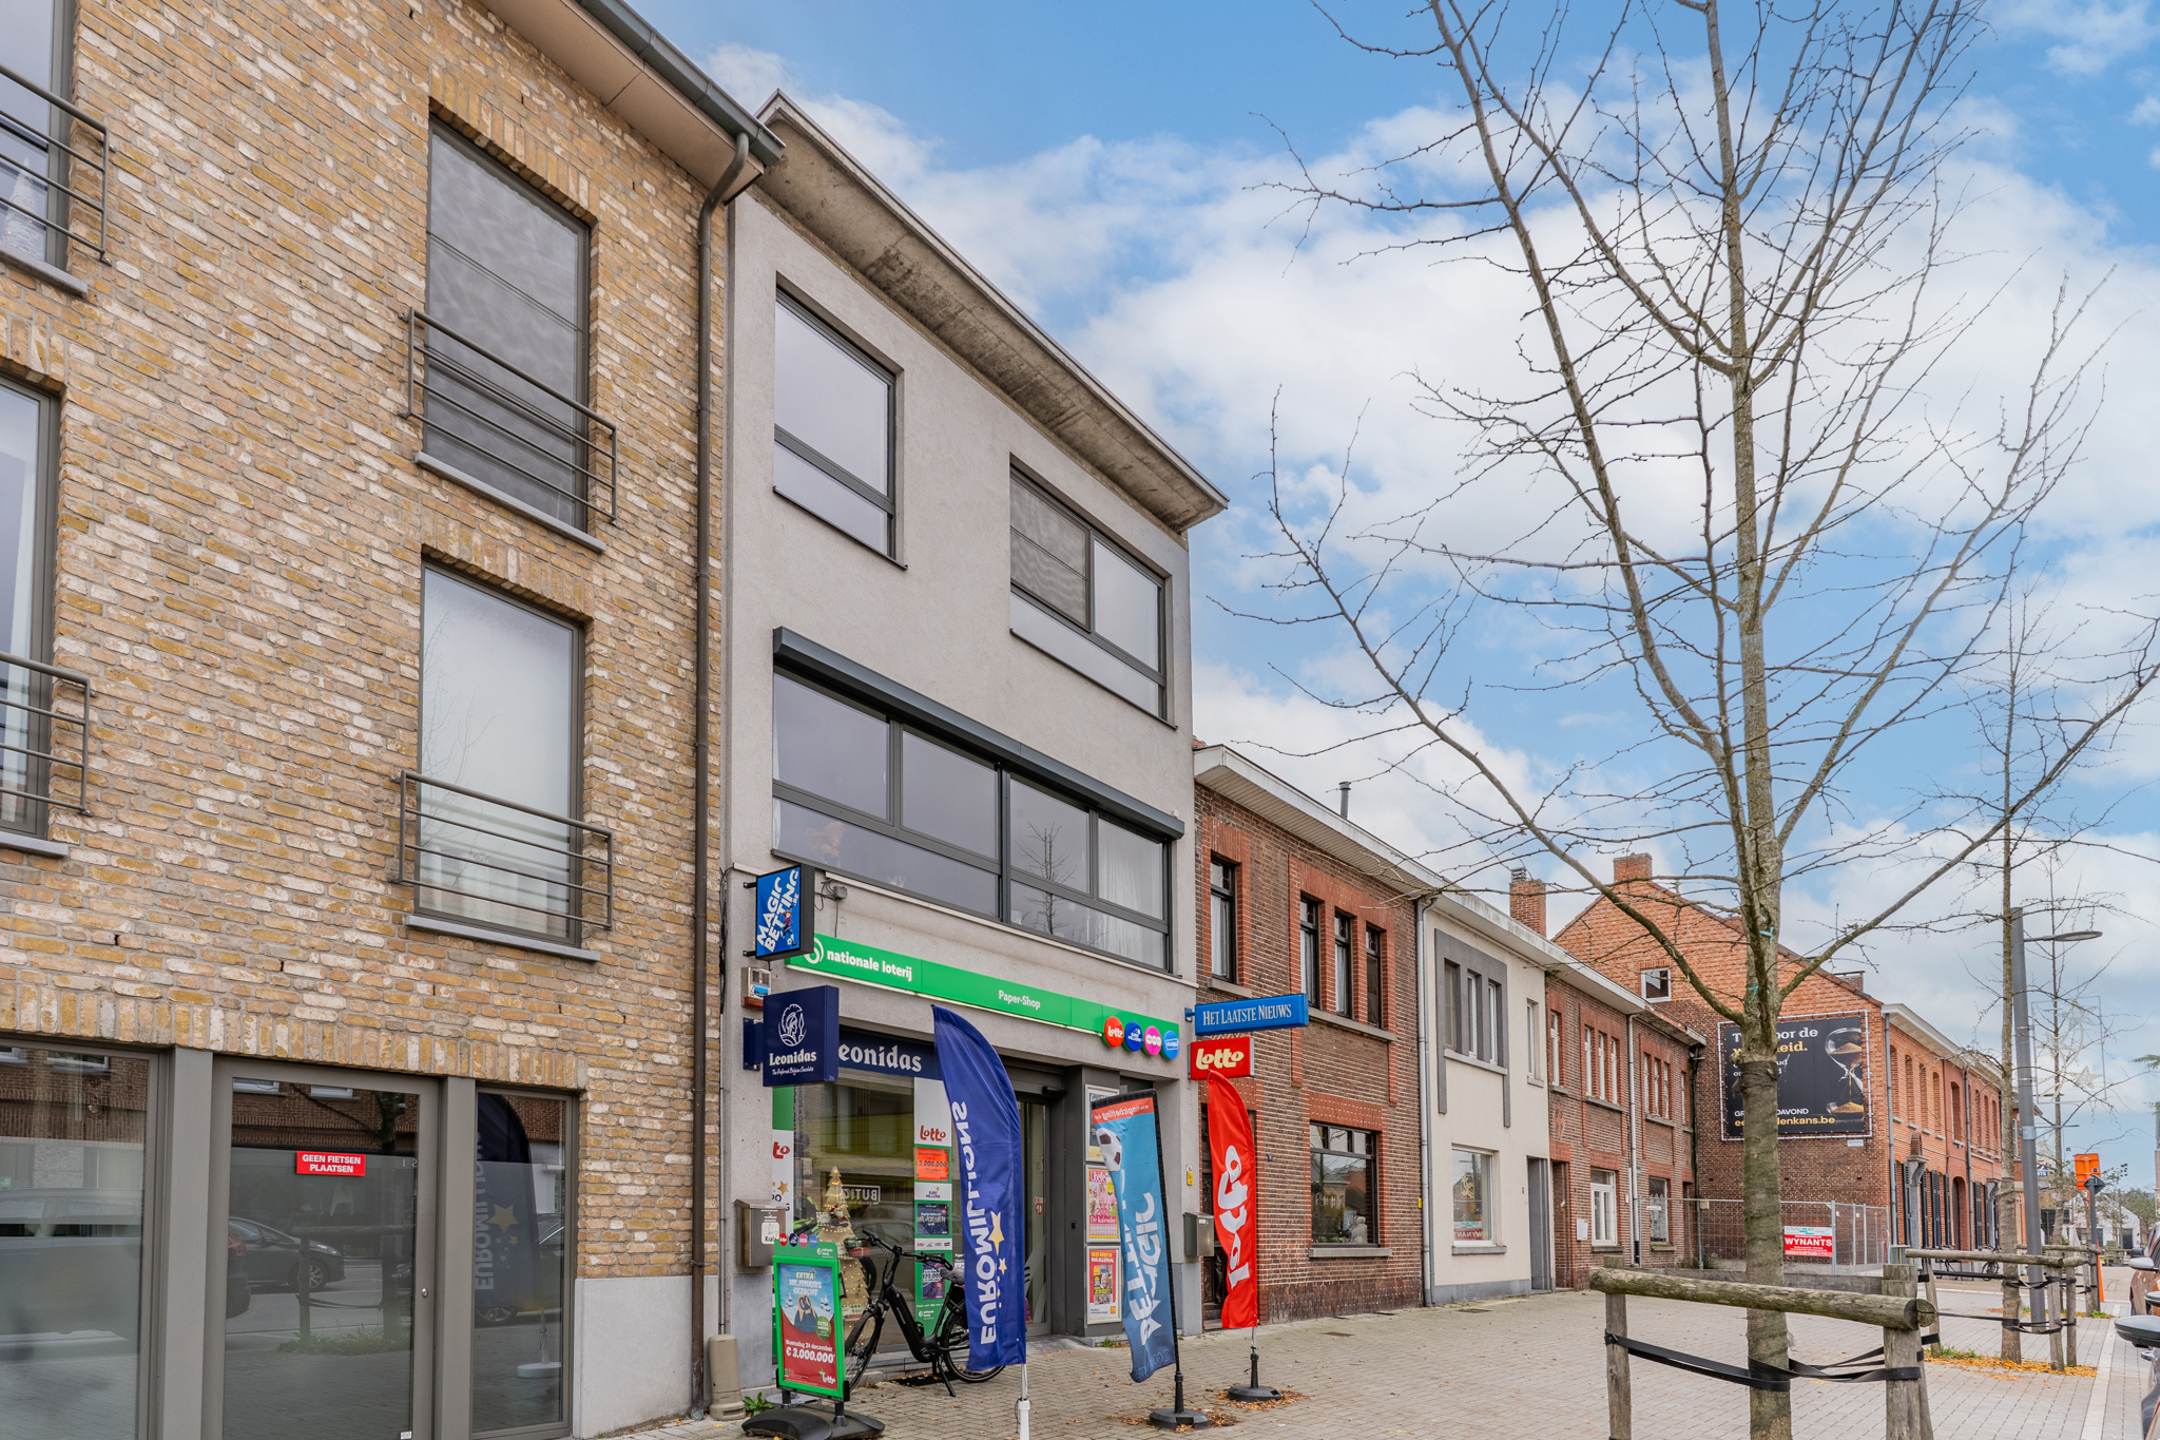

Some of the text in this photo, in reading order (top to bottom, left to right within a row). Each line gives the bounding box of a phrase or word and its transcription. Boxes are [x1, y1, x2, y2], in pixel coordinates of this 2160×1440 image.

[757, 877, 782, 946] MAGIC
[764, 869, 799, 952] BETTING
[826, 949, 912, 982] nationale loterij
[998, 989, 1041, 1011] Paper-Shop
[1203, 1004, 1292, 1026] HET LAATSTE NIEUWS
[1799, 1027, 1818, 1038] de
[769, 1048, 817, 1066] Leonidas
[838, 1044, 922, 1072] eonidas
[302, 1154, 361, 1164] GEEN FIETSEN
[309, 1164, 354, 1173] PLAATSEN
[1785, 1237, 1832, 1246] WYNANTS
[796, 1271, 814, 1280] EXTRA
[785, 1346, 792, 1357] €
[811, 1343, 833, 1352] december
